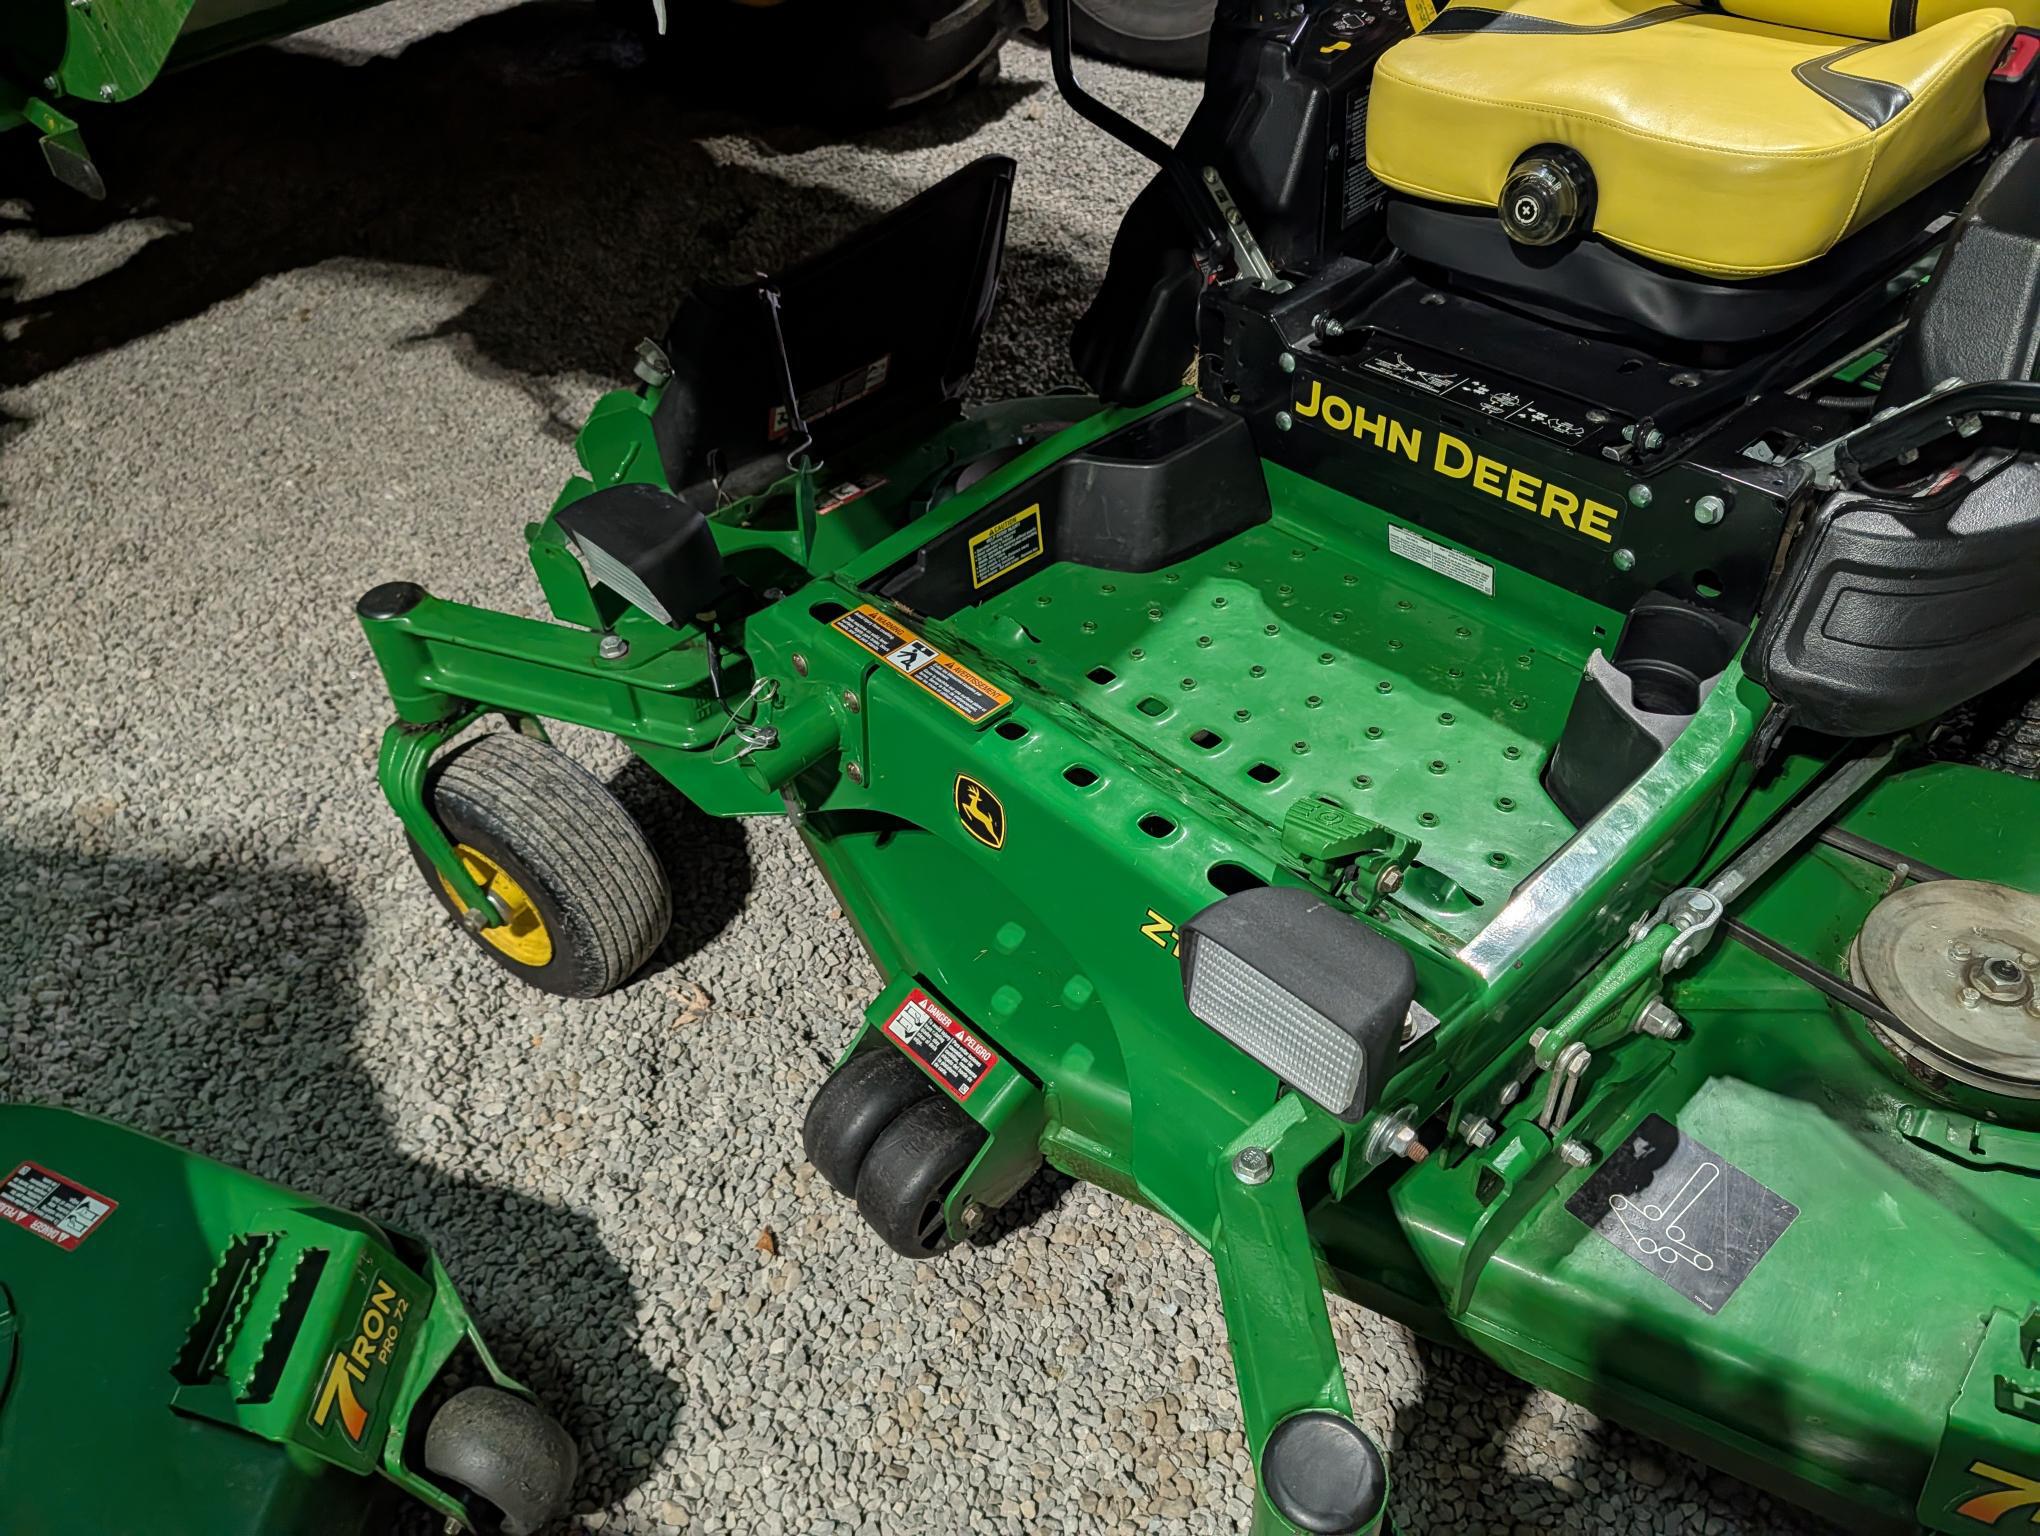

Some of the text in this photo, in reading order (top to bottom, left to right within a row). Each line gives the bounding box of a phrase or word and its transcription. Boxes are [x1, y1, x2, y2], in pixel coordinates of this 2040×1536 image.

[1295, 380, 1618, 544] JOHN DEERE
[994, 516, 1017, 533] CAUTION
[876, 614, 905, 636] WARNING
[953, 666, 1002, 699] AVERTISSEMENT
[927, 1003, 953, 1027] DANGER
[964, 1035, 992, 1061] PELIGRO
[30, 1220, 60, 1240] DANGER
[378, 1297, 409, 1365] PRO 72
